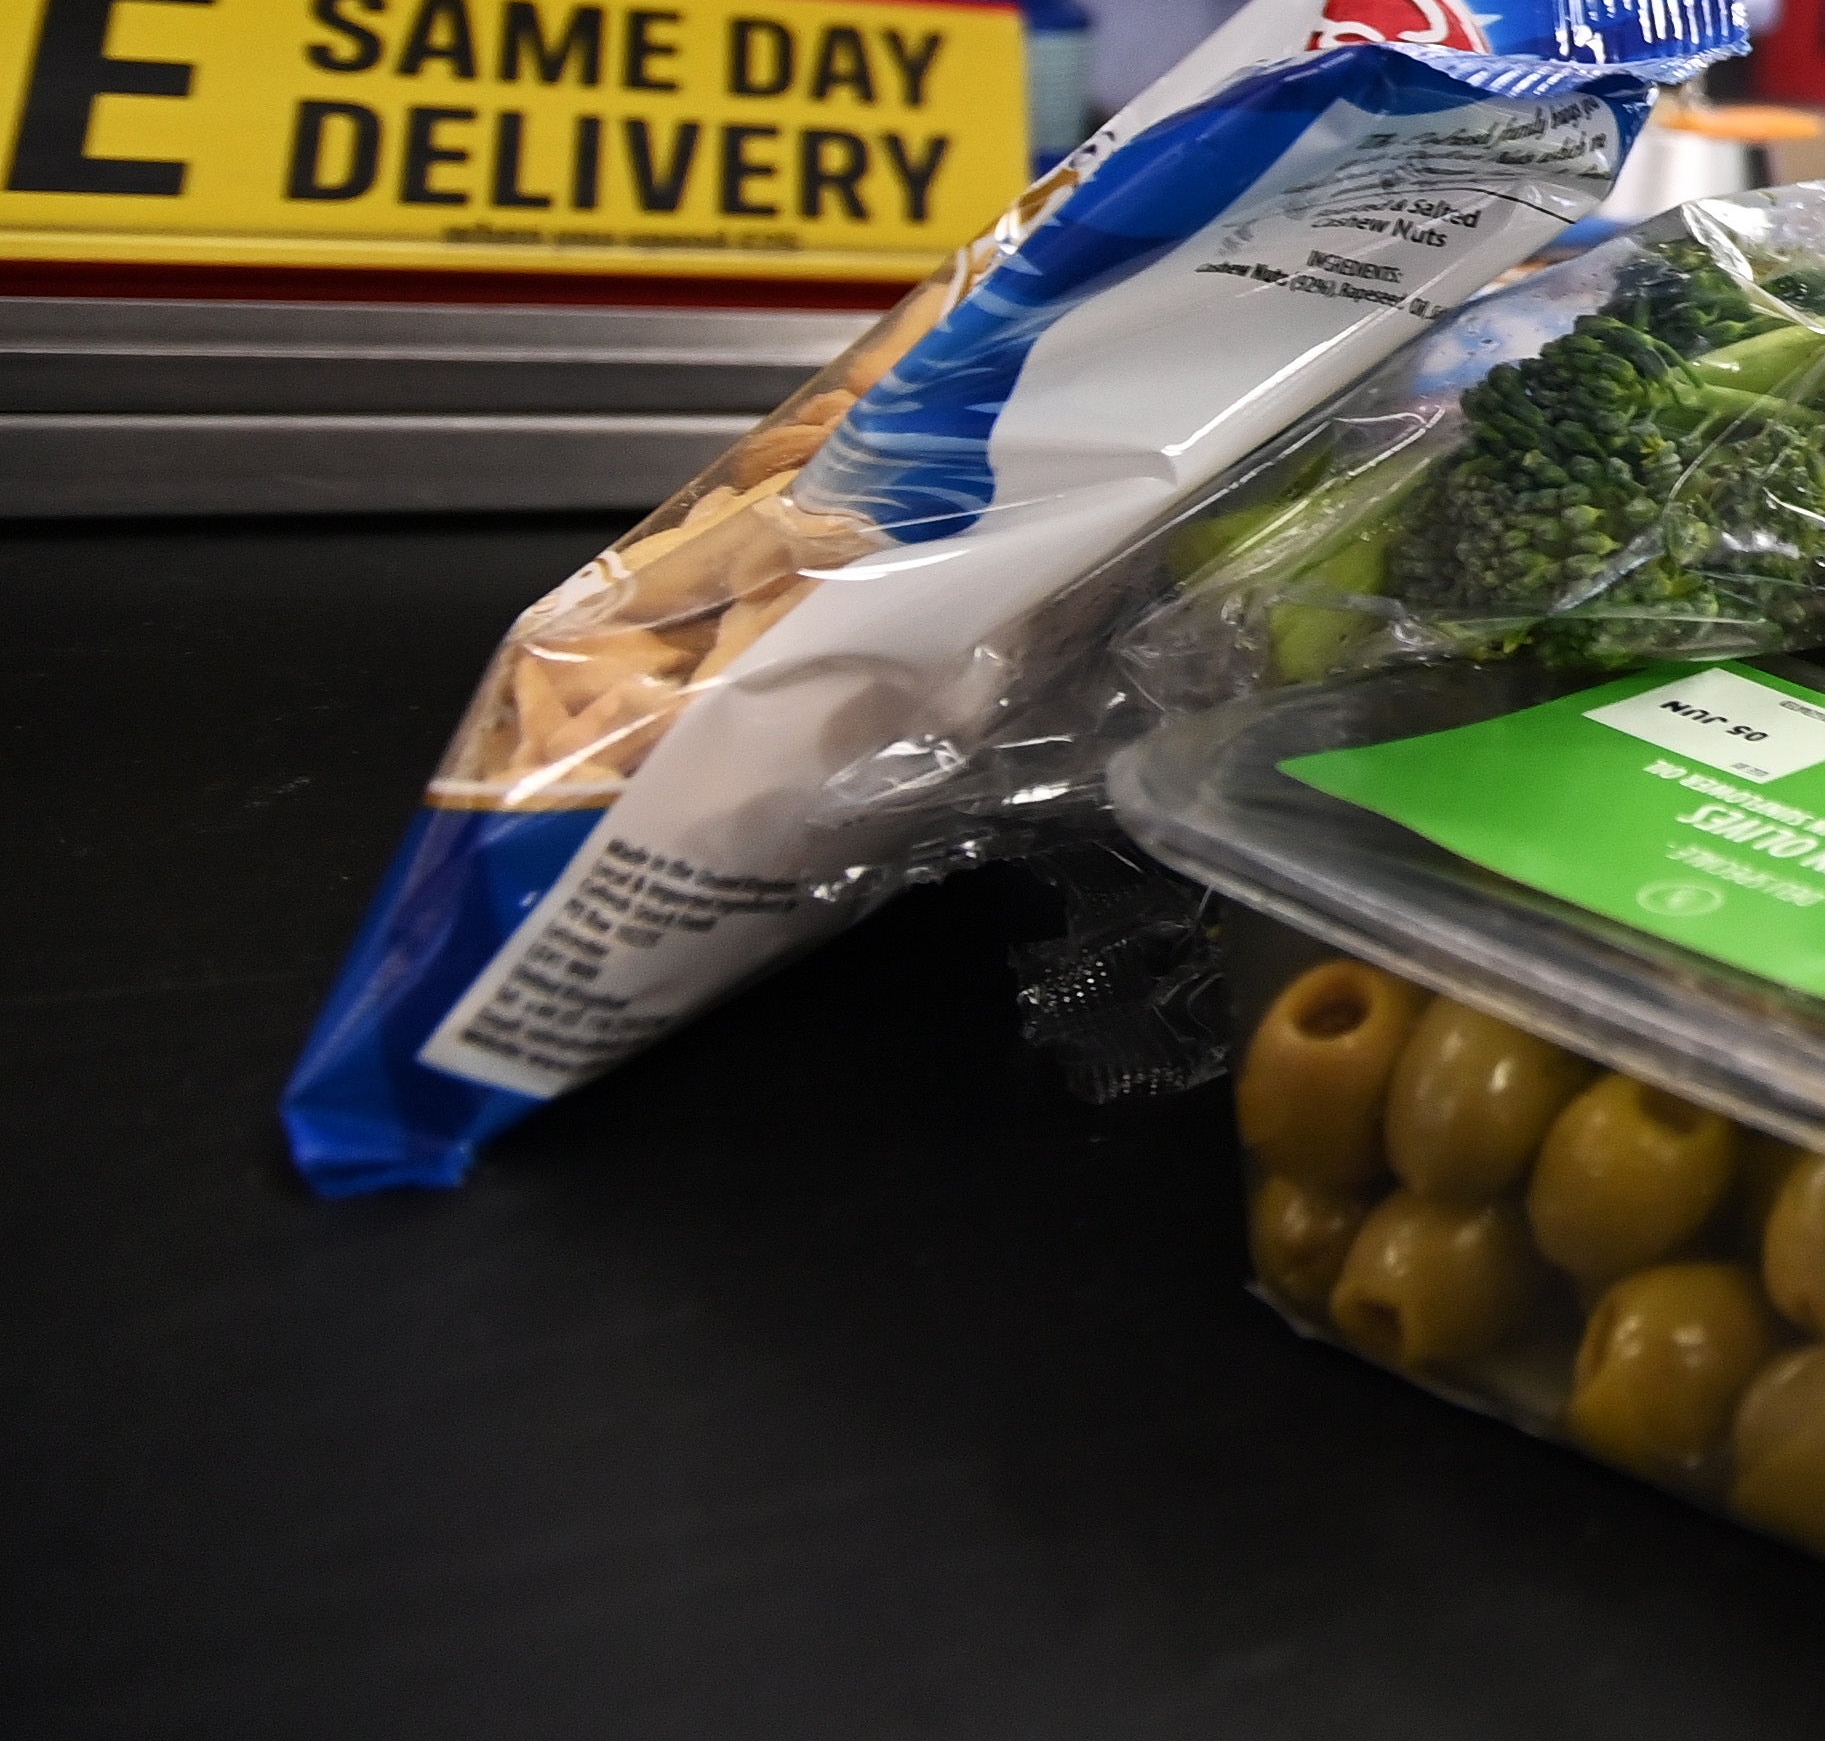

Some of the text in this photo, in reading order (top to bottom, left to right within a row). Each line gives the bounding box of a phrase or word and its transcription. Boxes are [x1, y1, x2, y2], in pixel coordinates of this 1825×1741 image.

[729, 11, 947, 108] DAY
[286, 97, 953, 225] DELIVERY
[1391, 217, 1448, 248] Nuts
[1657, 698, 1770, 744] 05 JUN
[1675, 802, 1819, 859] OLIVES
